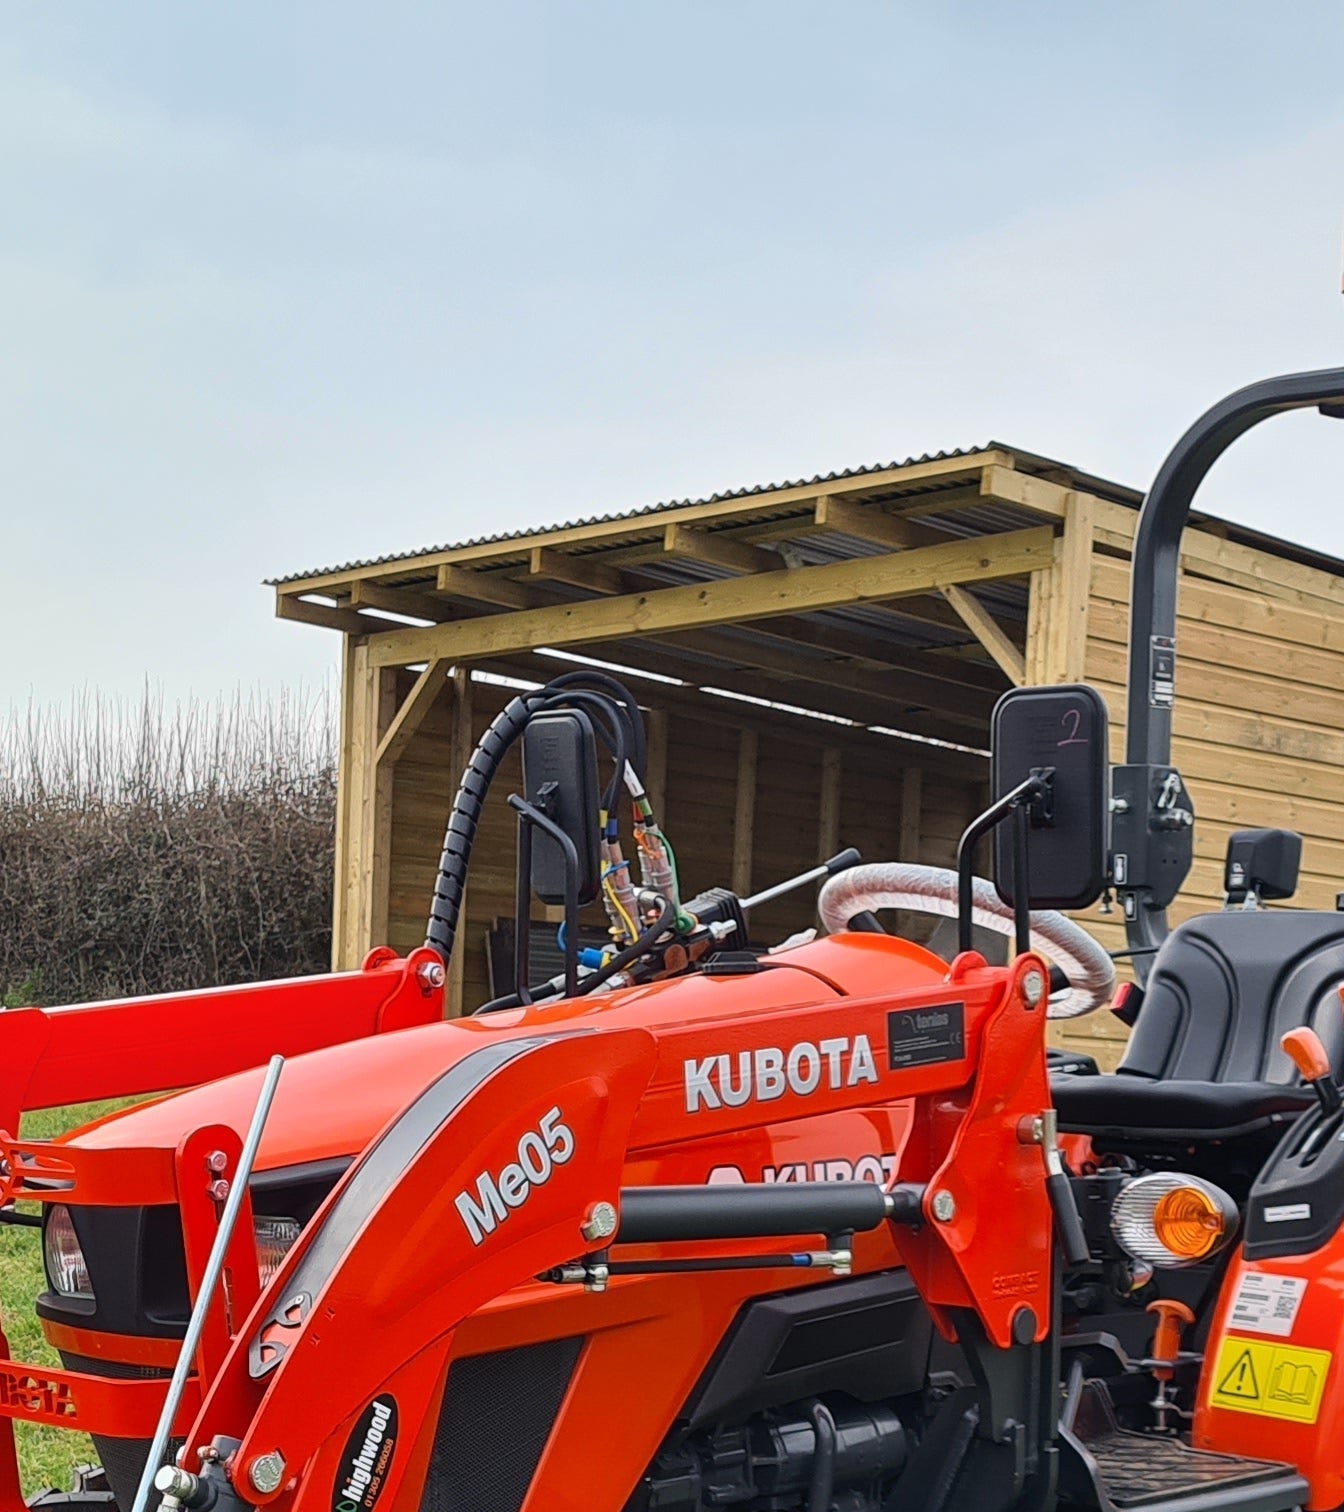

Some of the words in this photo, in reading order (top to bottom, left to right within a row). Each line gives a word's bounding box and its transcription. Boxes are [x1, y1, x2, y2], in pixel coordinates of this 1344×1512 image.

[1057, 709, 1089, 747] 2
[684, 1035, 878, 1112] KUBOTA
[454, 1105, 575, 1247] Me05
[342, 1400, 392, 1503] highwood
[364, 1475, 381, 1508] 01305
